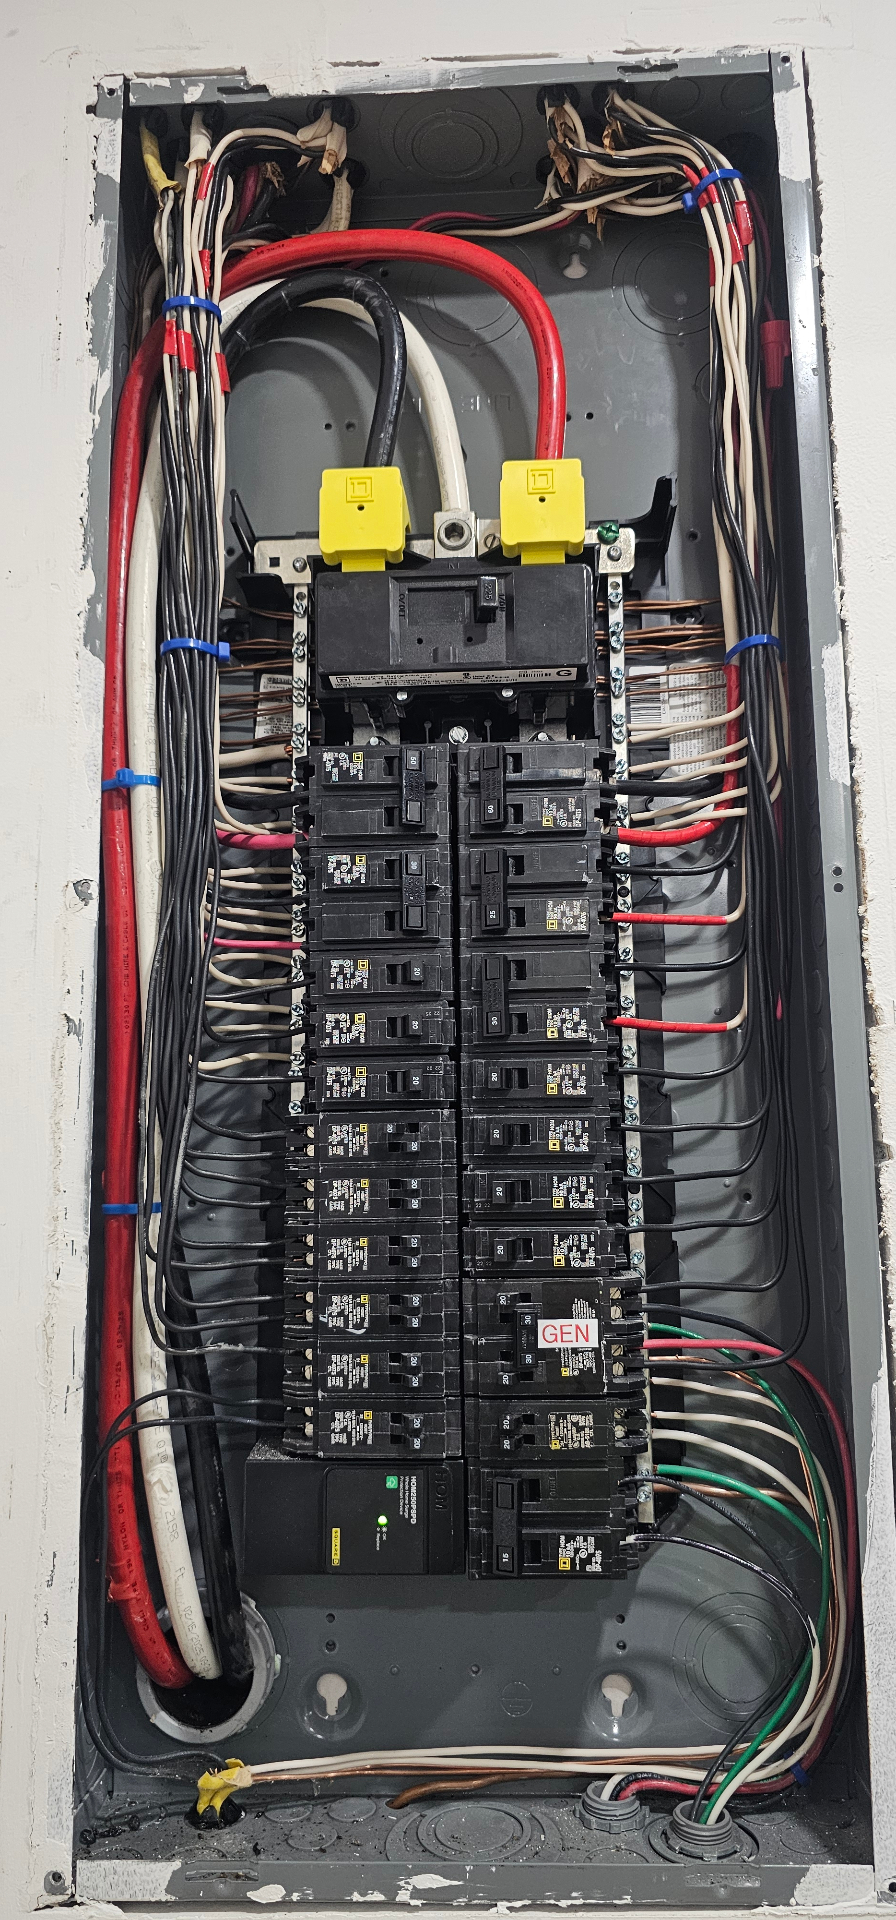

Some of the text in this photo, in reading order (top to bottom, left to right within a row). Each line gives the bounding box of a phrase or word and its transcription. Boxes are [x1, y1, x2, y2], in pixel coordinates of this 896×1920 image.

[146, 702, 156, 732] WIRE
[414, 967, 420, 976] 20
[412, 1021, 418, 1030] 20
[413, 1076, 419, 1085] 20
[492, 1072, 498, 1081] 20
[387, 1124, 393, 1133] 20
[494, 1130, 500, 1138] 20
[412, 1142, 418, 1150] 20
[412, 1180, 418, 1188] 20
[497, 1187, 502, 1196] 20
[412, 1199, 418, 1208] 20
[412, 1238, 418, 1247] 20
[498, 1246, 504, 1254] 20
[412, 1258, 418, 1267] 20
[413, 1297, 419, 1306] 20
[500, 1295, 506, 1304] 20
[412, 1318, 418, 1327] 20
[525, 1315, 531, 1324] 30
[542, 1324, 590, 1343] GEN
[411, 1357, 417, 1366] 20
[526, 1355, 532, 1364] 30
[412, 1377, 418, 1386] 20
[503, 1375, 509, 1384] 20
[414, 1418, 420, 1428] 20
[503, 1419, 509, 1429] 20
[414, 1439, 420, 1449] 20
[504, 1440, 510, 1449] 20
[435, 1472, 449, 1511] HOM
[164, 1509, 179, 1543] 2198
[174, 1566, 185, 1579] ft
